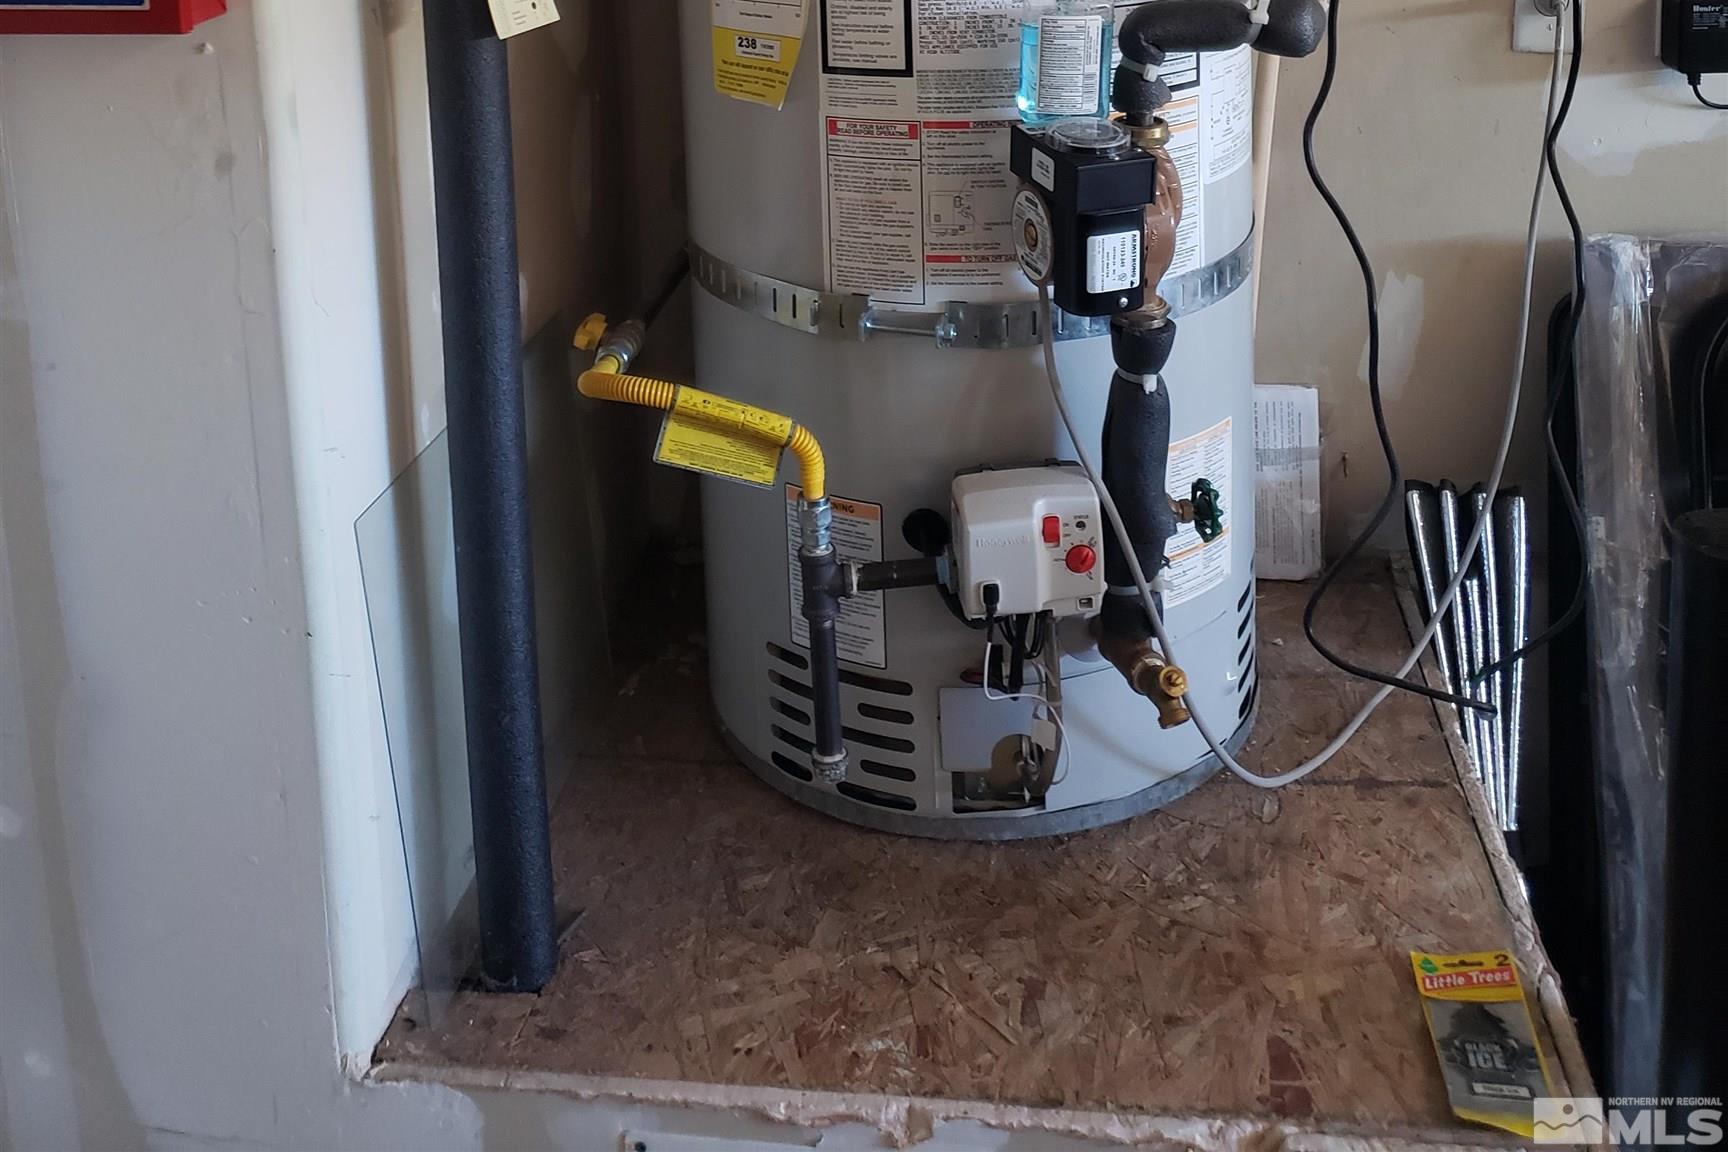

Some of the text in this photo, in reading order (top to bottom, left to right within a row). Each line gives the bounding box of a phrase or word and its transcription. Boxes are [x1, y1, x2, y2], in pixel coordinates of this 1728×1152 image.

[737, 36, 758, 49] 238
[1494, 954, 1510, 966] 2
[1424, 970, 1511, 990] Little Trees
[1467, 1050, 1507, 1069] ICE
